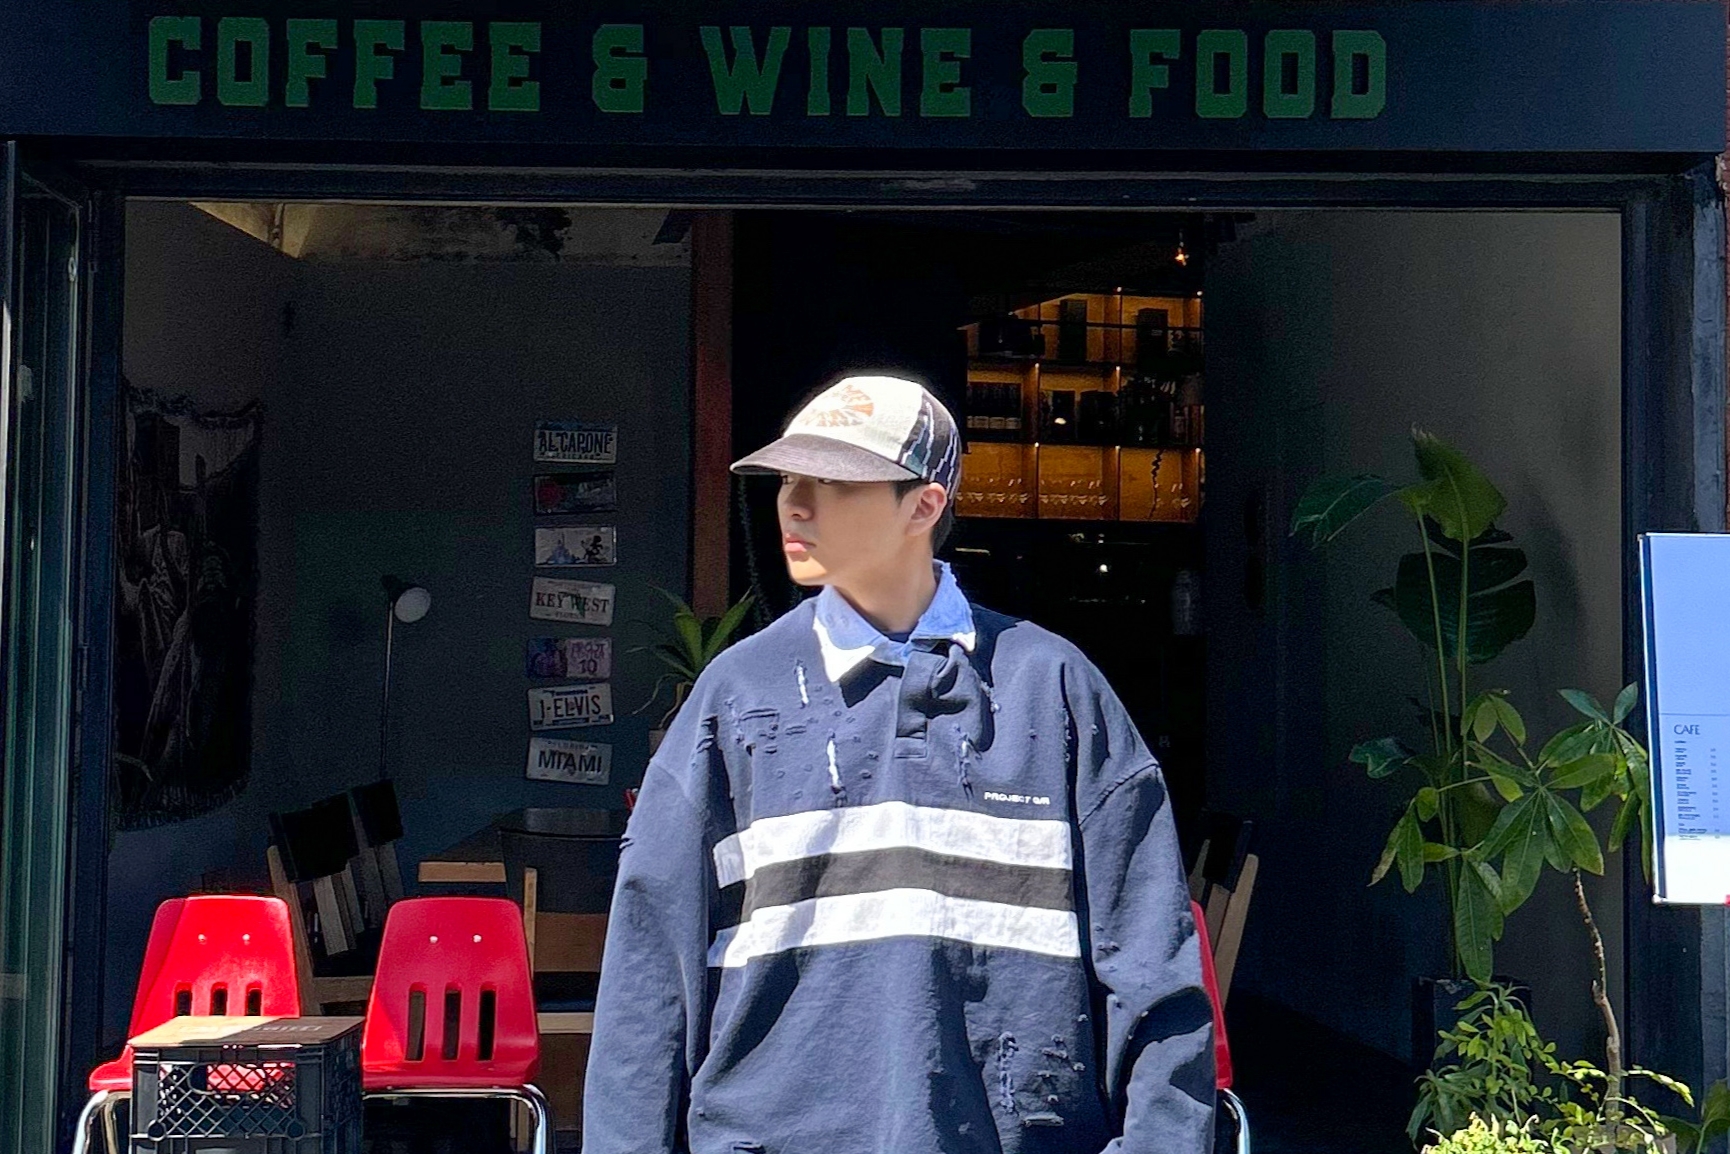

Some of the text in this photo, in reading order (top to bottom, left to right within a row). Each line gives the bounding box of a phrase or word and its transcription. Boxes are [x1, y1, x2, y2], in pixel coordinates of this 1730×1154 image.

[149, 16, 1386, 118] COFFEE & WINE & FOOD
[538, 431, 612, 454] AL CAPONE
[536, 591, 609, 613] KEY WEST
[1674, 724, 1700, 735] CAFE
[538, 750, 602, 772] MIAMI
[984, 791, 1031, 803] PROJECT
